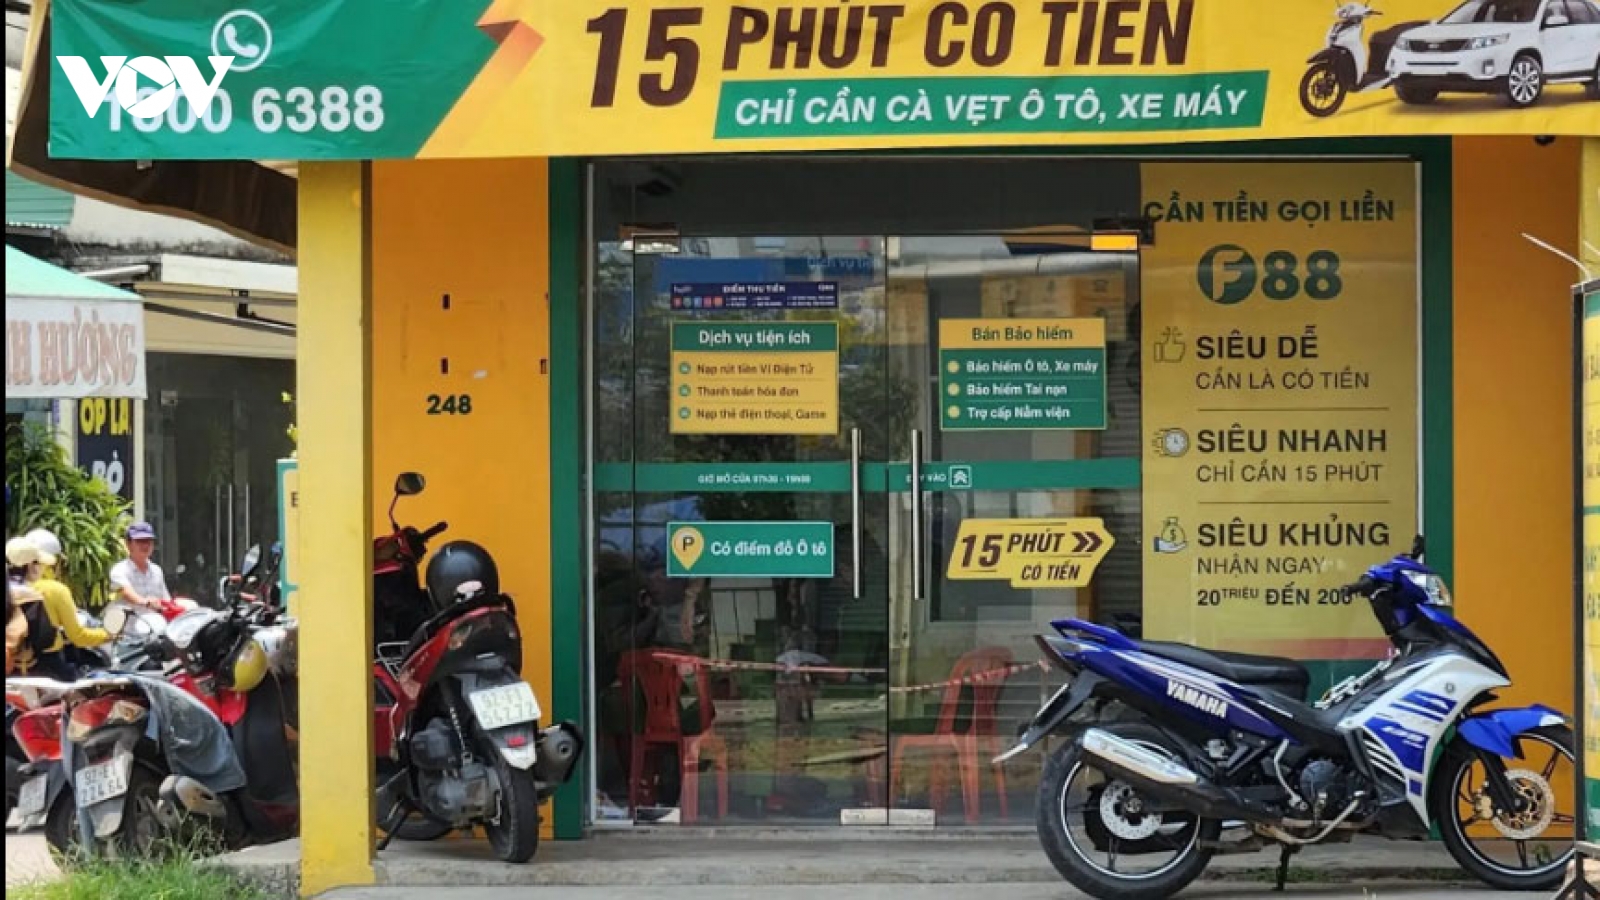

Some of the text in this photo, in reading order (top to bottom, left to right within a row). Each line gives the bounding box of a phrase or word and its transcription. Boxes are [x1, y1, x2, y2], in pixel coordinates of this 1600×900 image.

[585, 7, 703, 107] 15
[252, 86, 384, 133] 6388
[735, 84, 1248, 126] CHỈ CẦN CÀ VẸT Ô TÔ, XE MÁY
[1144, 189, 1394, 228] CẦN TIỀN GỌI LIỀN
[1197, 244, 1343, 305] F88
[699, 329, 810, 347] Dịch vụ tiện ích
[971, 325, 1073, 341] Bán Bảo hiểm
[1196, 325, 1319, 359] SIÊU DỄ
[697, 364, 717, 376] Nạp
[720, 363, 735, 374] rút
[966, 360, 989, 373] Bảo
[992, 360, 1022, 373] hiểm
[1024, 359, 1034, 373] Ô
[1055, 360, 1070, 373] Xe
[1073, 360, 1099, 374] máy
[1196, 367, 1370, 389] CẦN LÀ CÓ TIỀN
[697, 386, 730, 397] Thanh
[732, 387, 754, 397] toán
[757, 386, 777, 397] hóa
[966, 383, 1067, 397] Bảo hiểm Tai nạn
[426, 394, 472, 415] 248
[697, 409, 717, 420] Nạp
[739, 409, 762, 420] điện
[796, 408, 827, 419] Game
[967, 404, 1071, 420] Trợ cấp Nằm viện
[1197, 423, 1387, 453] SIÊU NHANH
[1196, 459, 1384, 482] CHỈ CẦN 15 PHÚT
[1197, 513, 1390, 547] SIÊU KHỦNG
[682, 535, 696, 551] P
[710, 541, 731, 556] Có
[734, 540, 771, 556] điểm
[797, 538, 808, 556] Ô
[812, 541, 827, 556] tô
[961, 528, 1066, 568] 15 PHÚT
[1021, 559, 1081, 580] CÓ TIỀN
[1197, 553, 1325, 578] NHẬN NGAY
[1265, 582, 1311, 606] ĐẾN
[1167, 680, 1227, 718] YAMAHA
